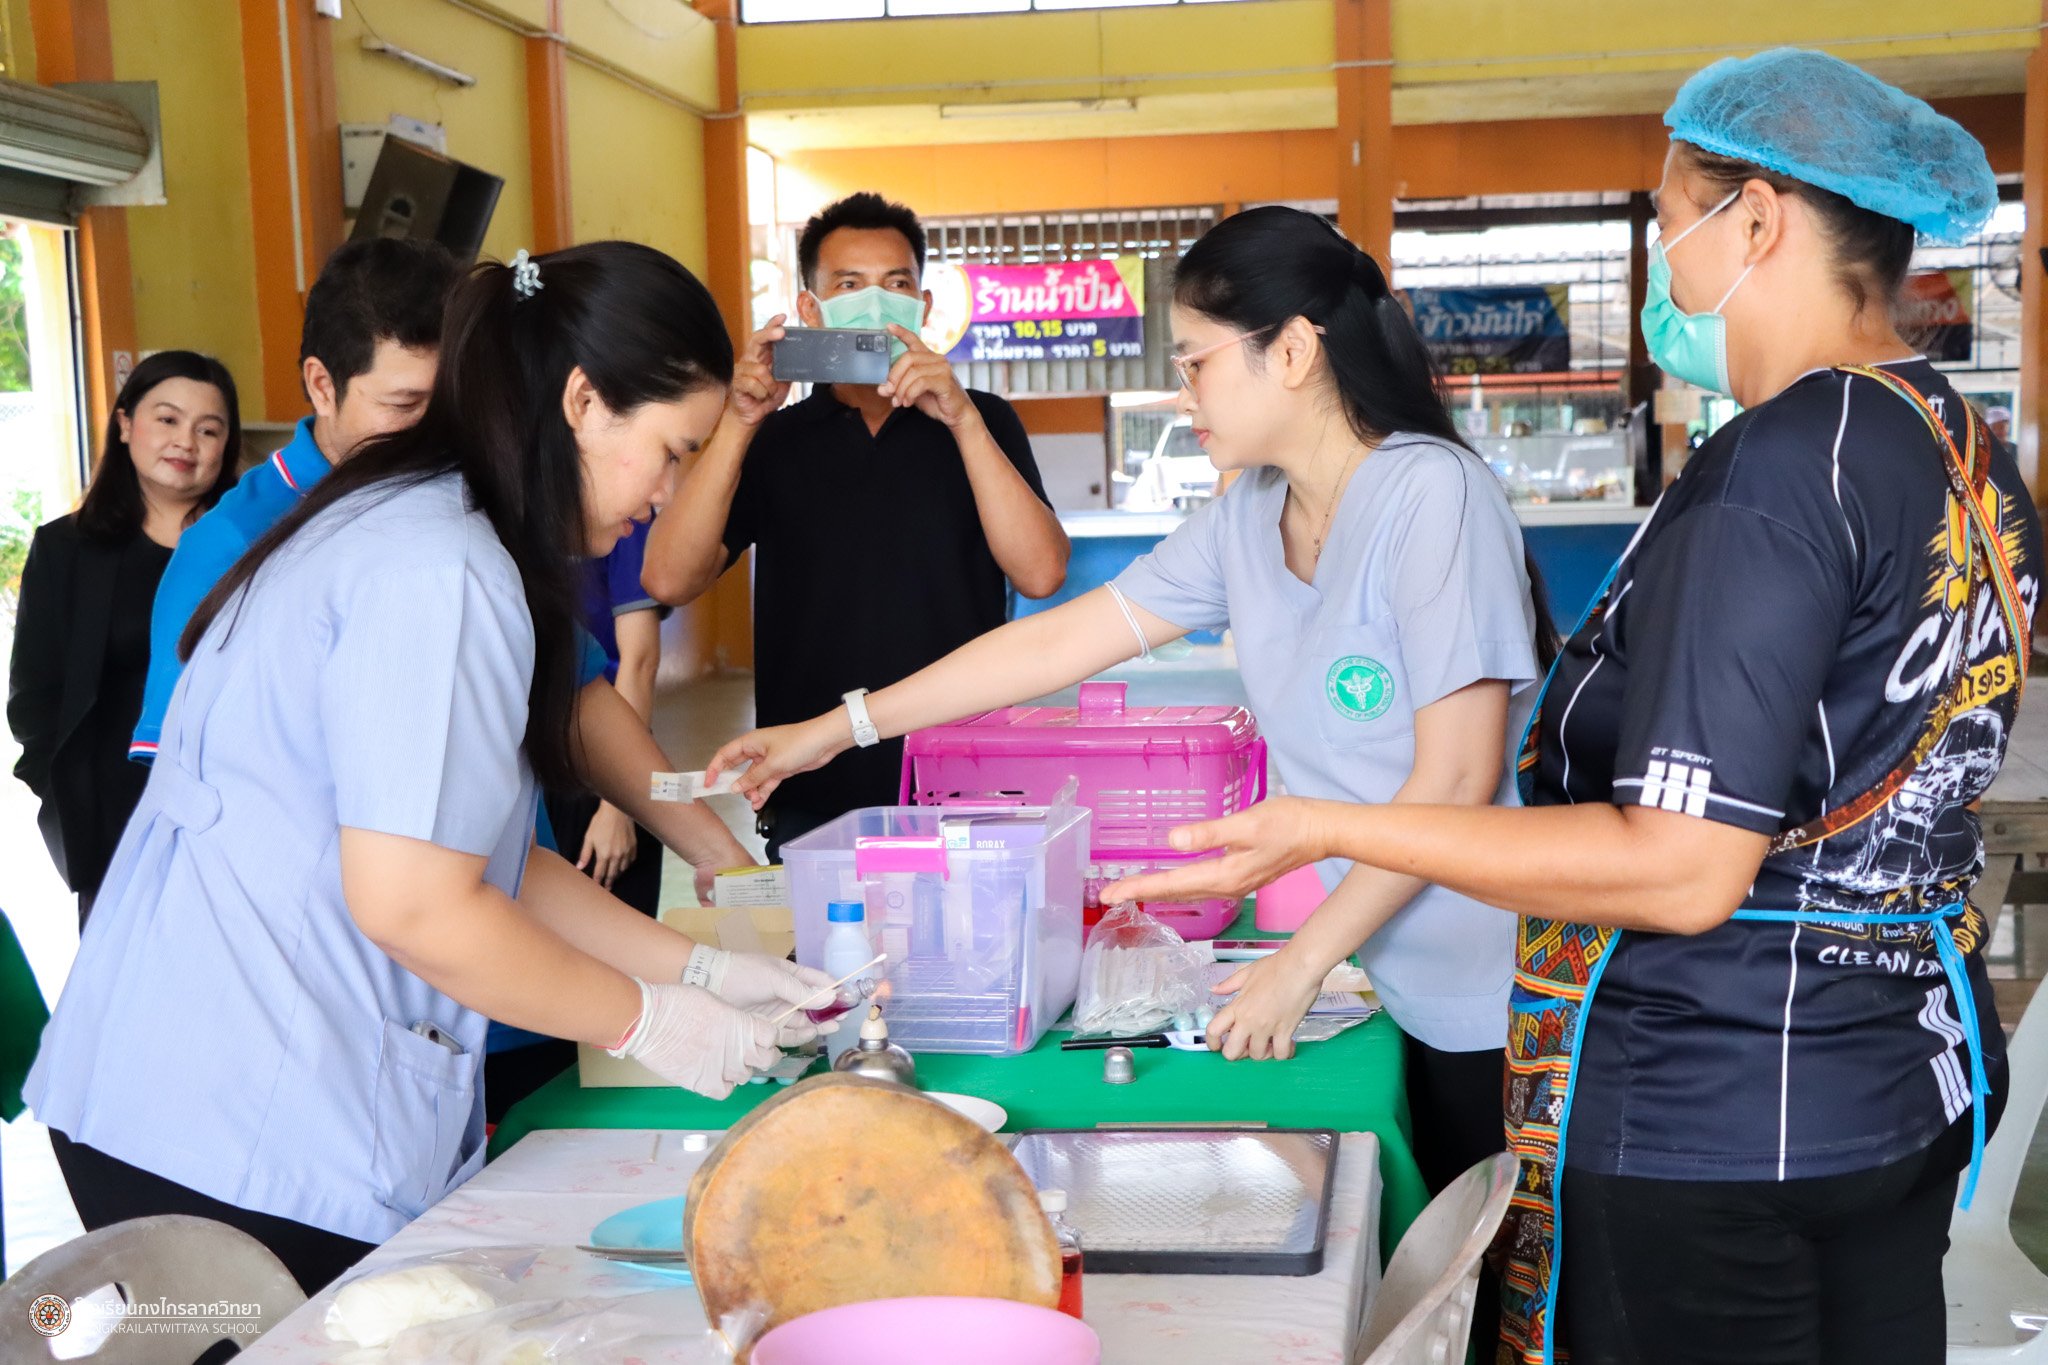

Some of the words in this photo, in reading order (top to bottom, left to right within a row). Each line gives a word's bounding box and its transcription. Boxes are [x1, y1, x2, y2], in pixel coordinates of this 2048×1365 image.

[977, 267, 1123, 315] ร้านน้ำปั่น
[972, 322, 1010, 338] ราคา
[1013, 319, 1063, 339] 10,15
[1065, 321, 1098, 337] บาท
[1418, 300, 1546, 337] ข้าวมันไก่
[1051, 343, 1090, 358] ราคา
[1092, 338, 1107, 357] 5
[1109, 342, 1142, 356] บาท
[1818, 944, 1910, 973] CLEAN
